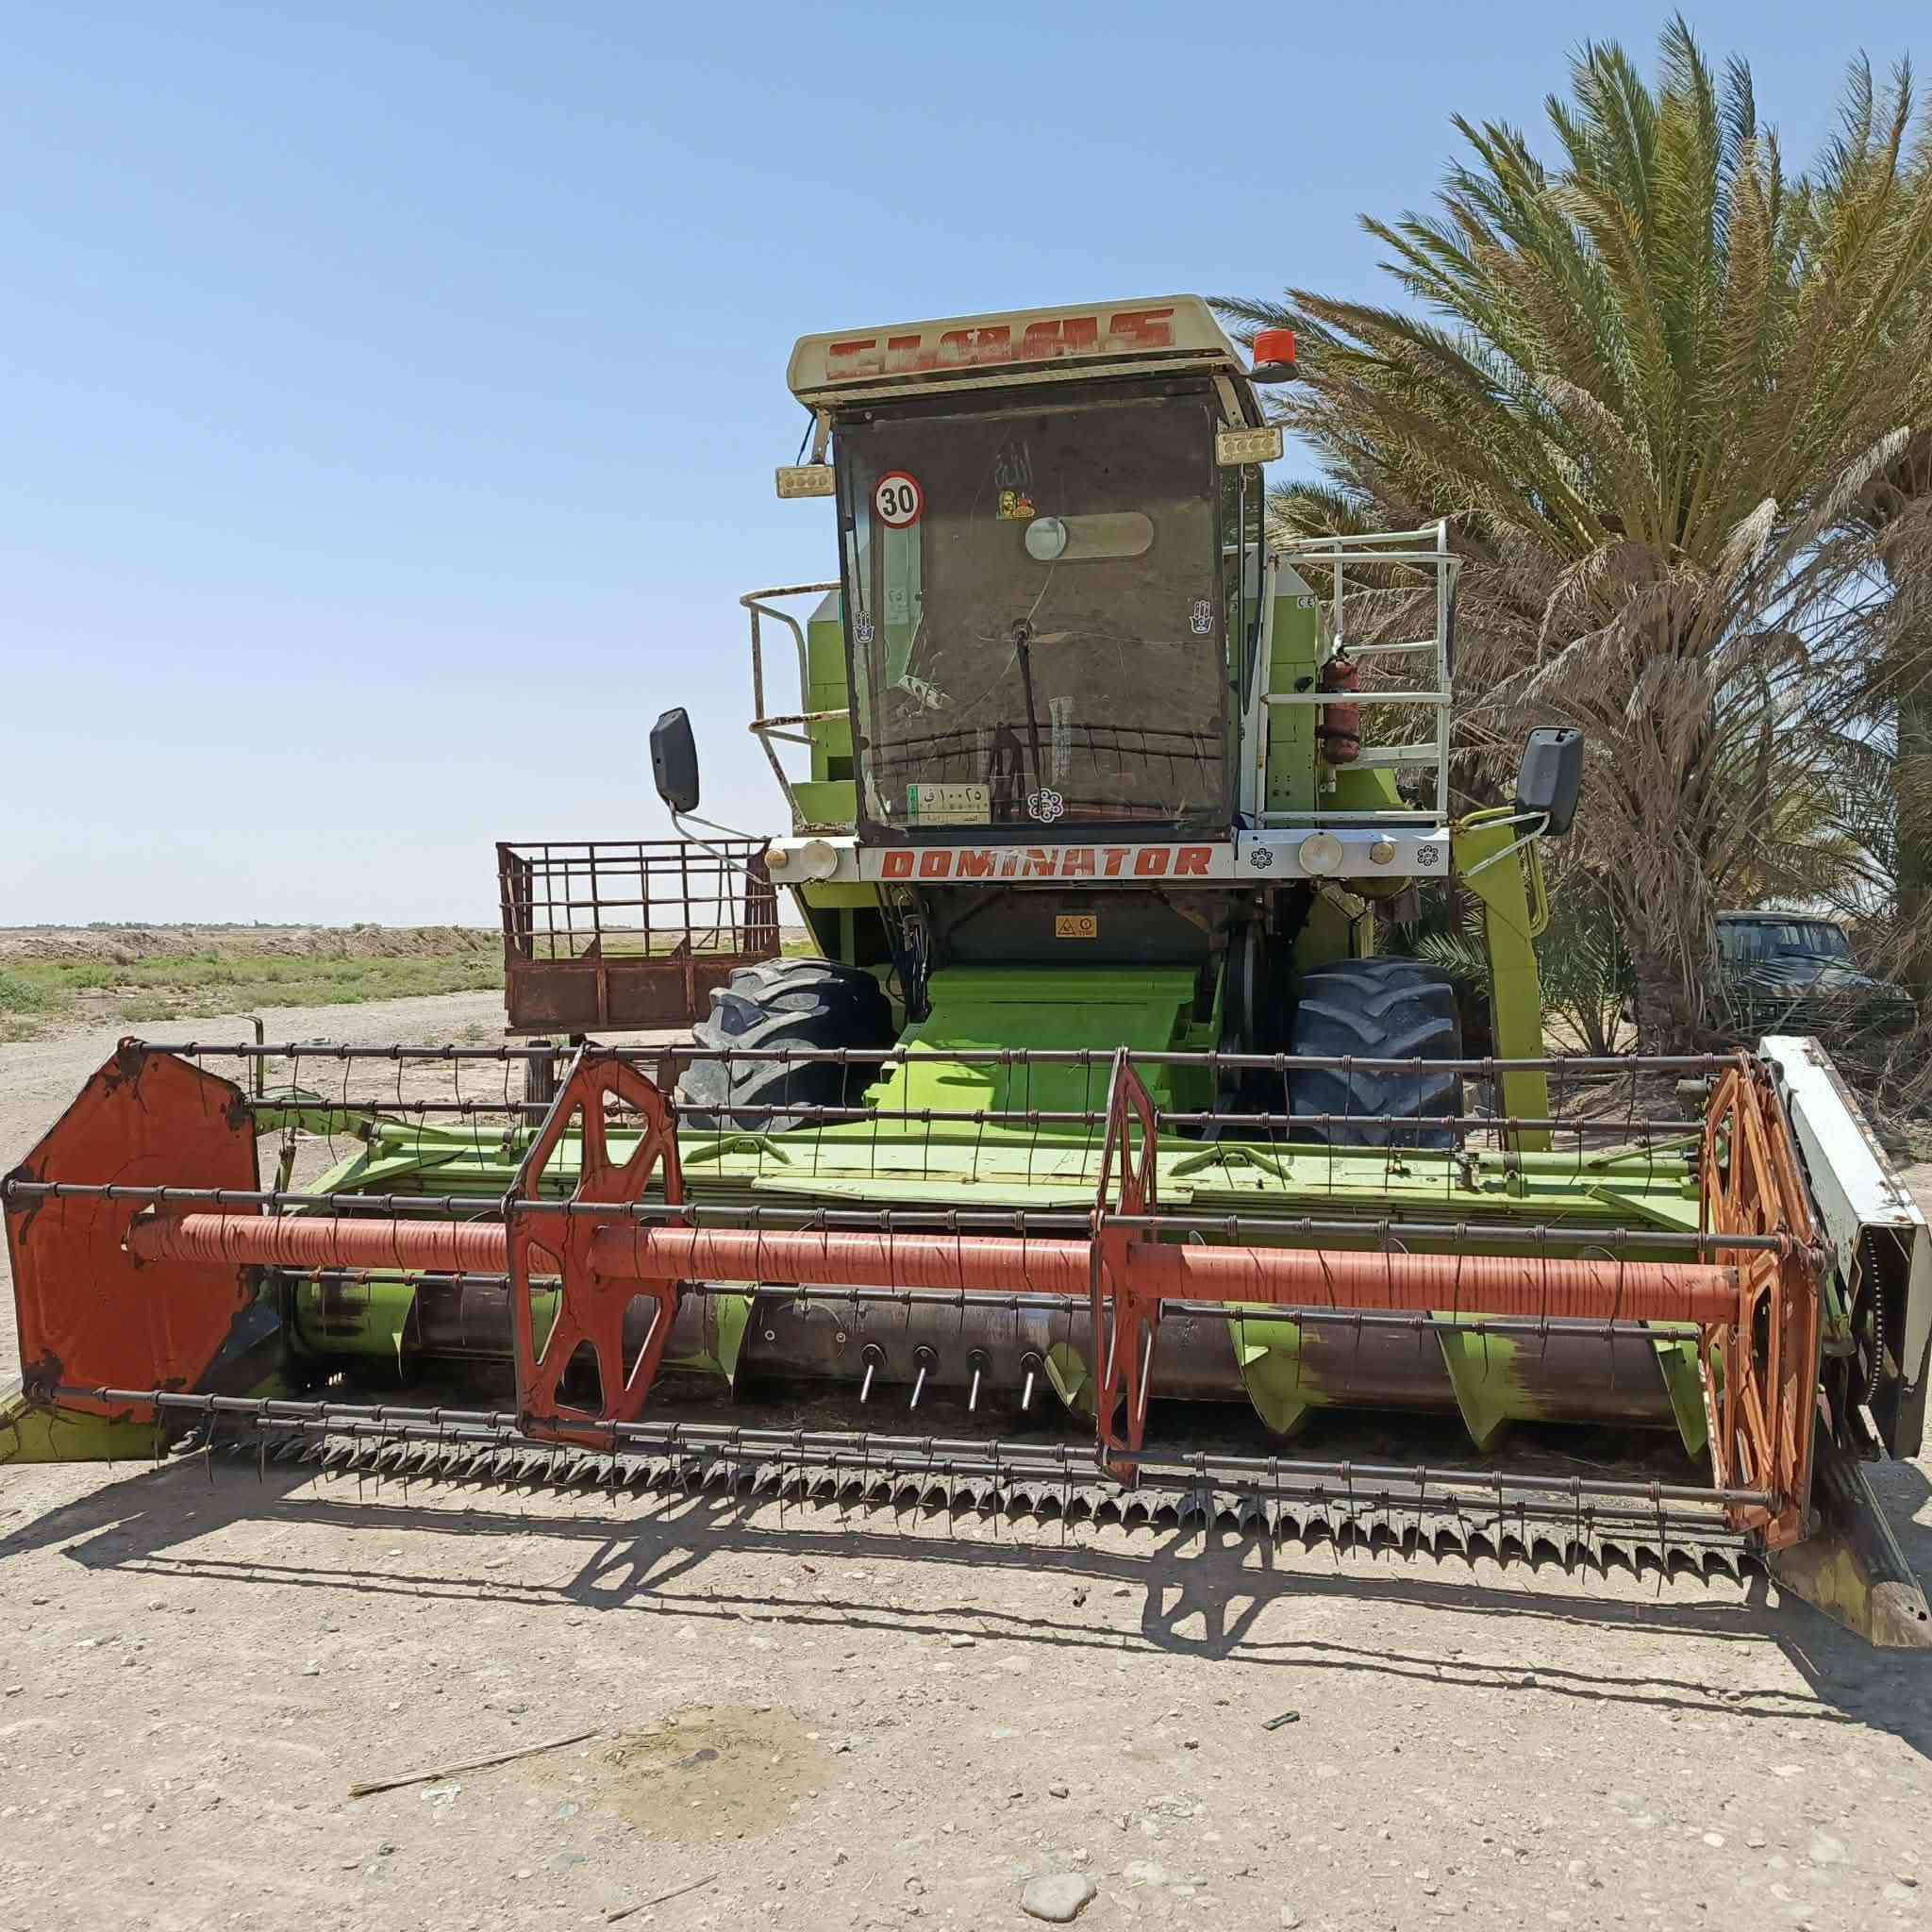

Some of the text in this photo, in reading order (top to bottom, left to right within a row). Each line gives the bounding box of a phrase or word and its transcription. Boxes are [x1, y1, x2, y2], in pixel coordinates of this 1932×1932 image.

[881, 485, 914, 516] 30
[1297, 597, 1314, 608] CE
[881, 847, 1212, 877] DOMINATOR
